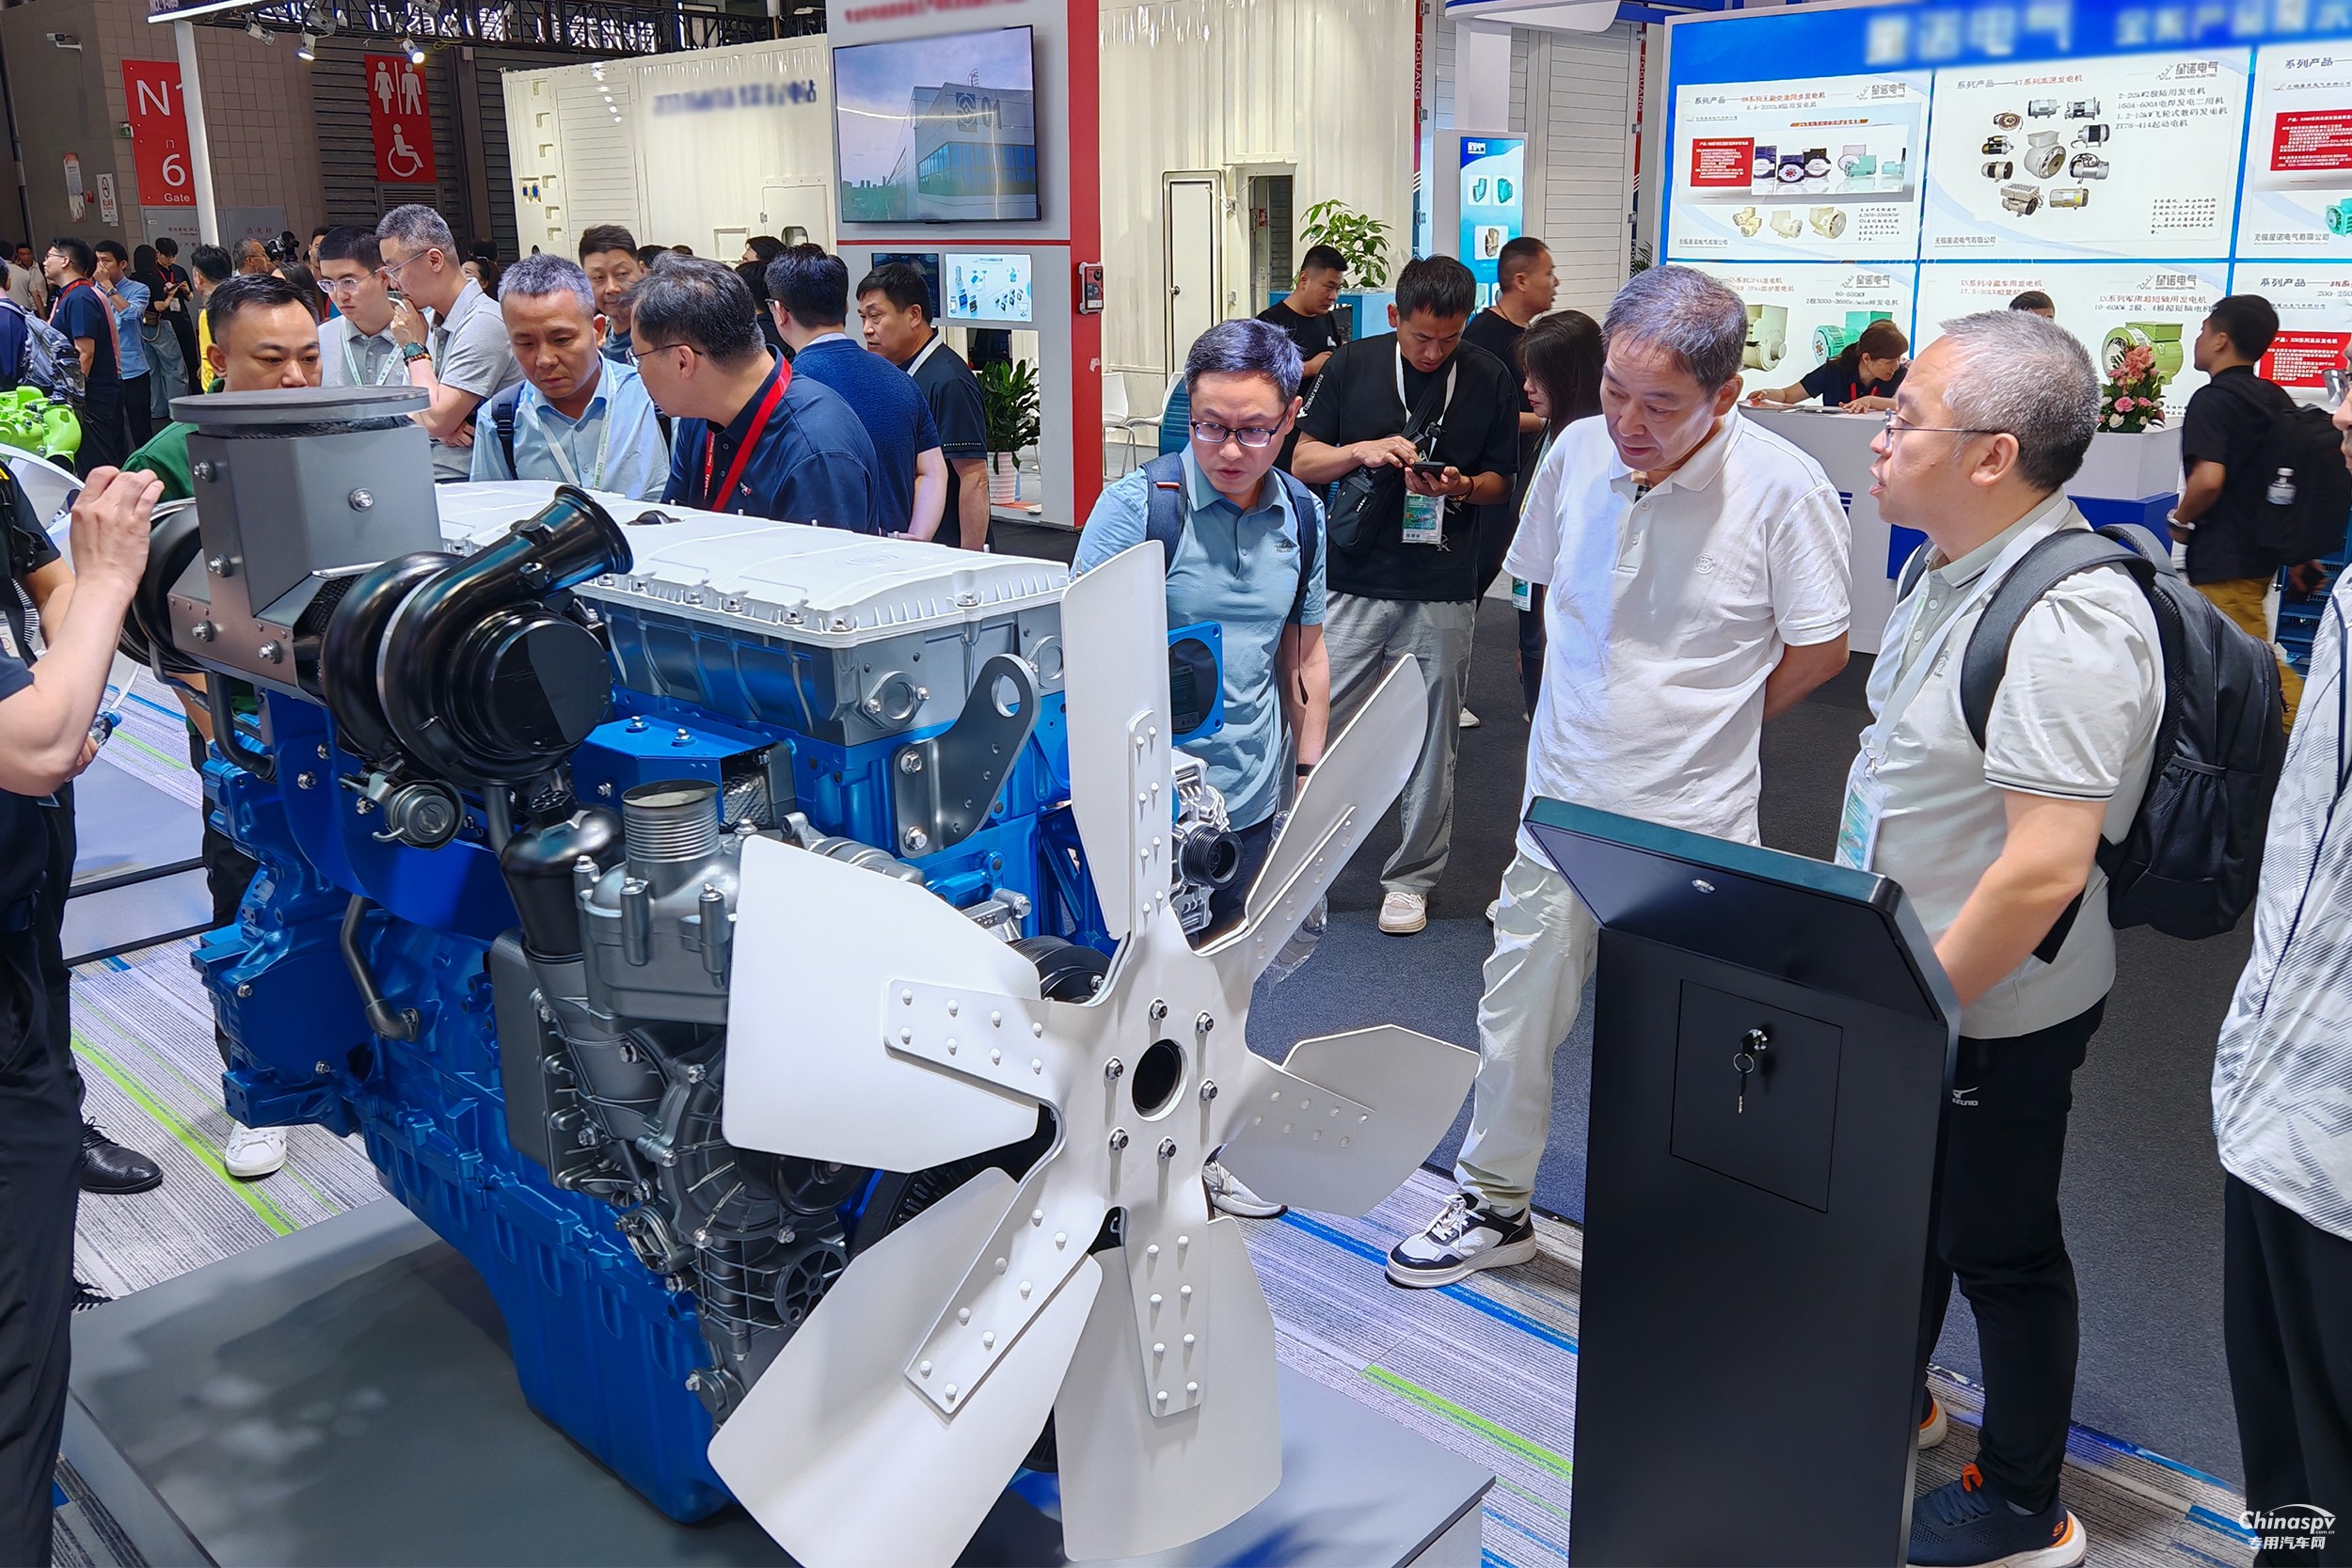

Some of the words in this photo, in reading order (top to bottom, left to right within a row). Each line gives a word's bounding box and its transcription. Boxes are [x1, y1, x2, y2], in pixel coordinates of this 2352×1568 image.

[136, 80, 183, 116] N
[981, 96, 1002, 129] 01
[162, 153, 186, 187] 6
[164, 193, 190, 202] Gate
